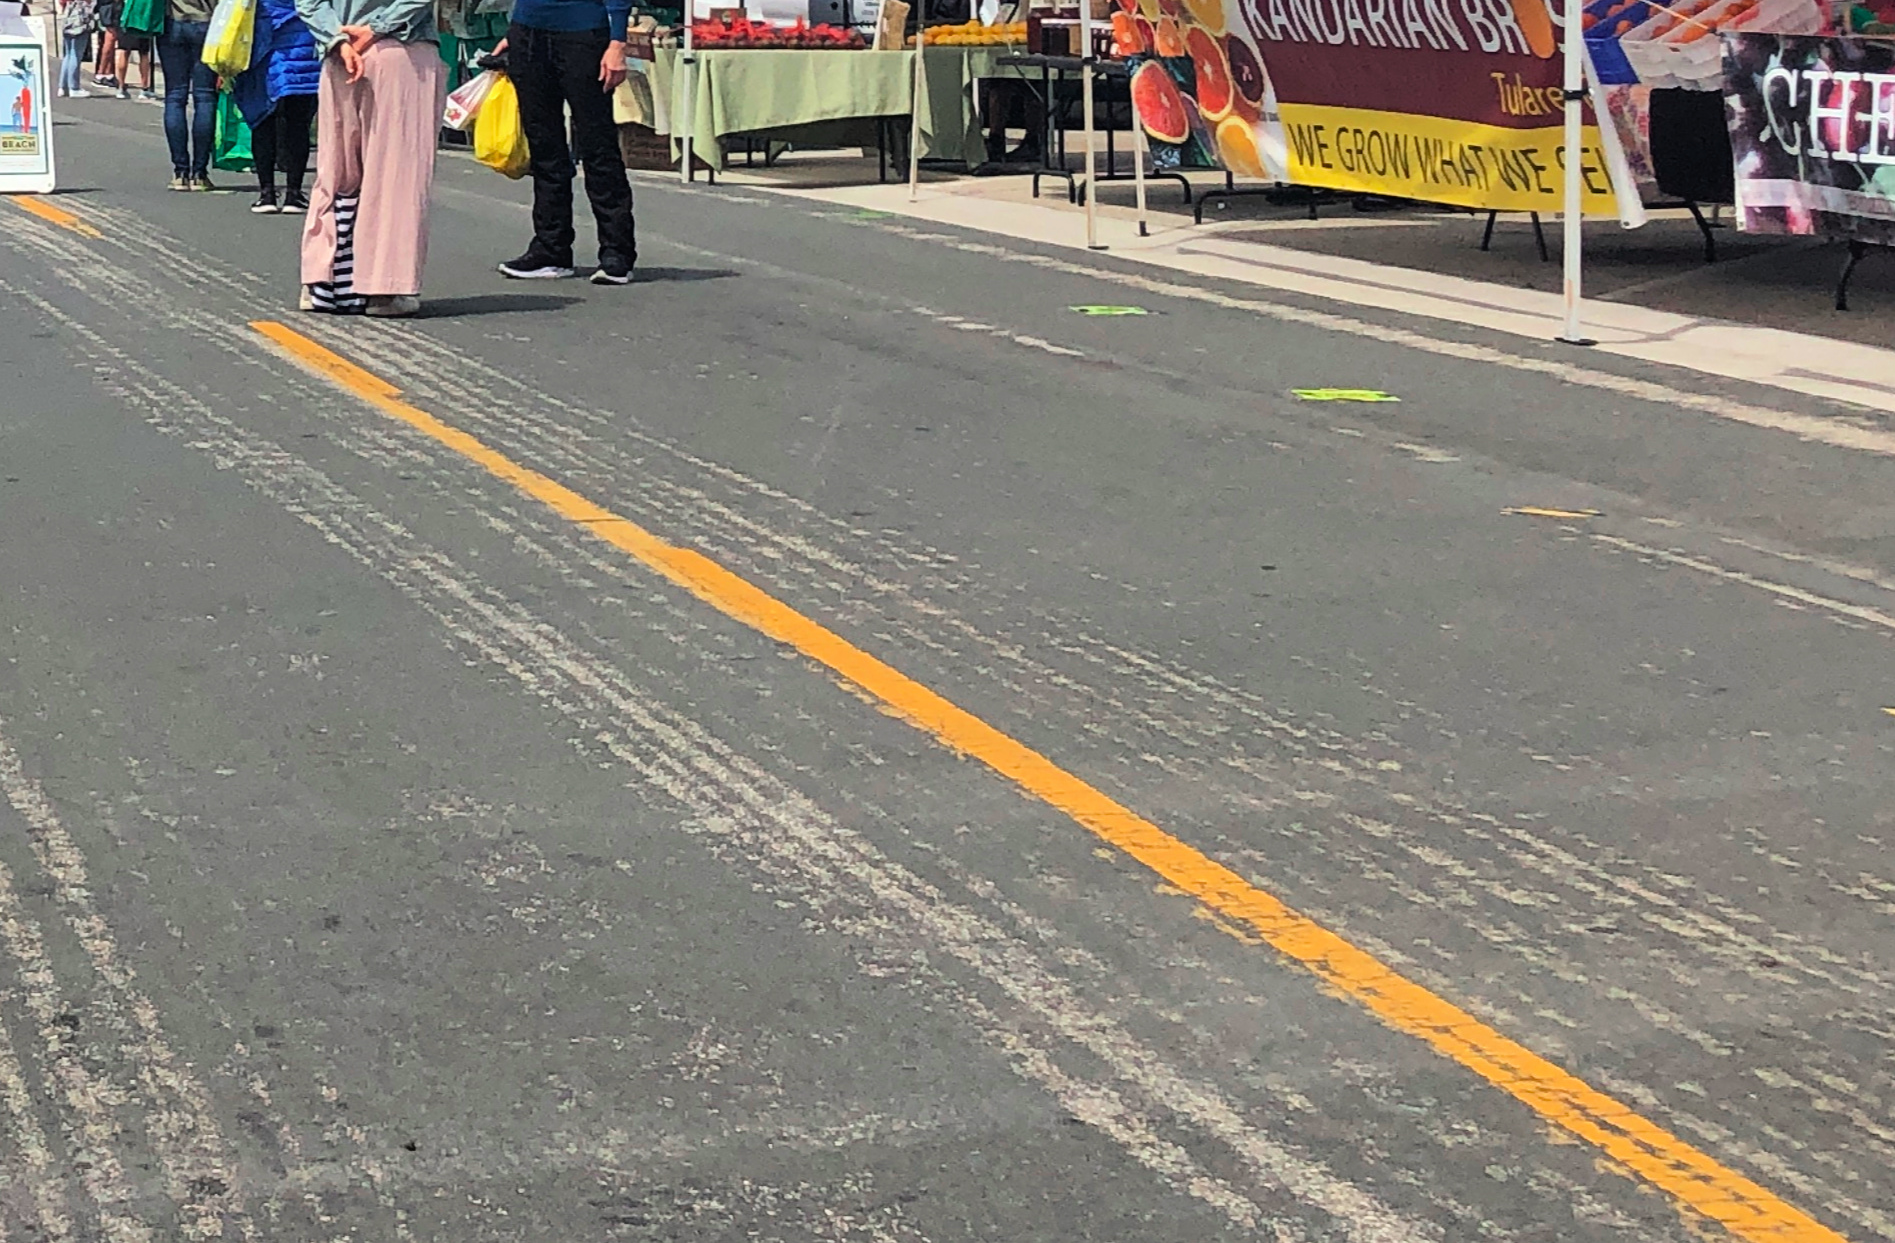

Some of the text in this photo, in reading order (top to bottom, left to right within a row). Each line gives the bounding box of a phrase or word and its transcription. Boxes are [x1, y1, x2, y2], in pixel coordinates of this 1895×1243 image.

[1490, 72, 1567, 116] Tulare
[1, 140, 36, 149] BEACH
[1287, 123, 1333, 169] WE
[1335, 127, 1410, 179] GROW
[1413, 136, 1490, 192] WHAT
[1489, 147, 1554, 194] WE
